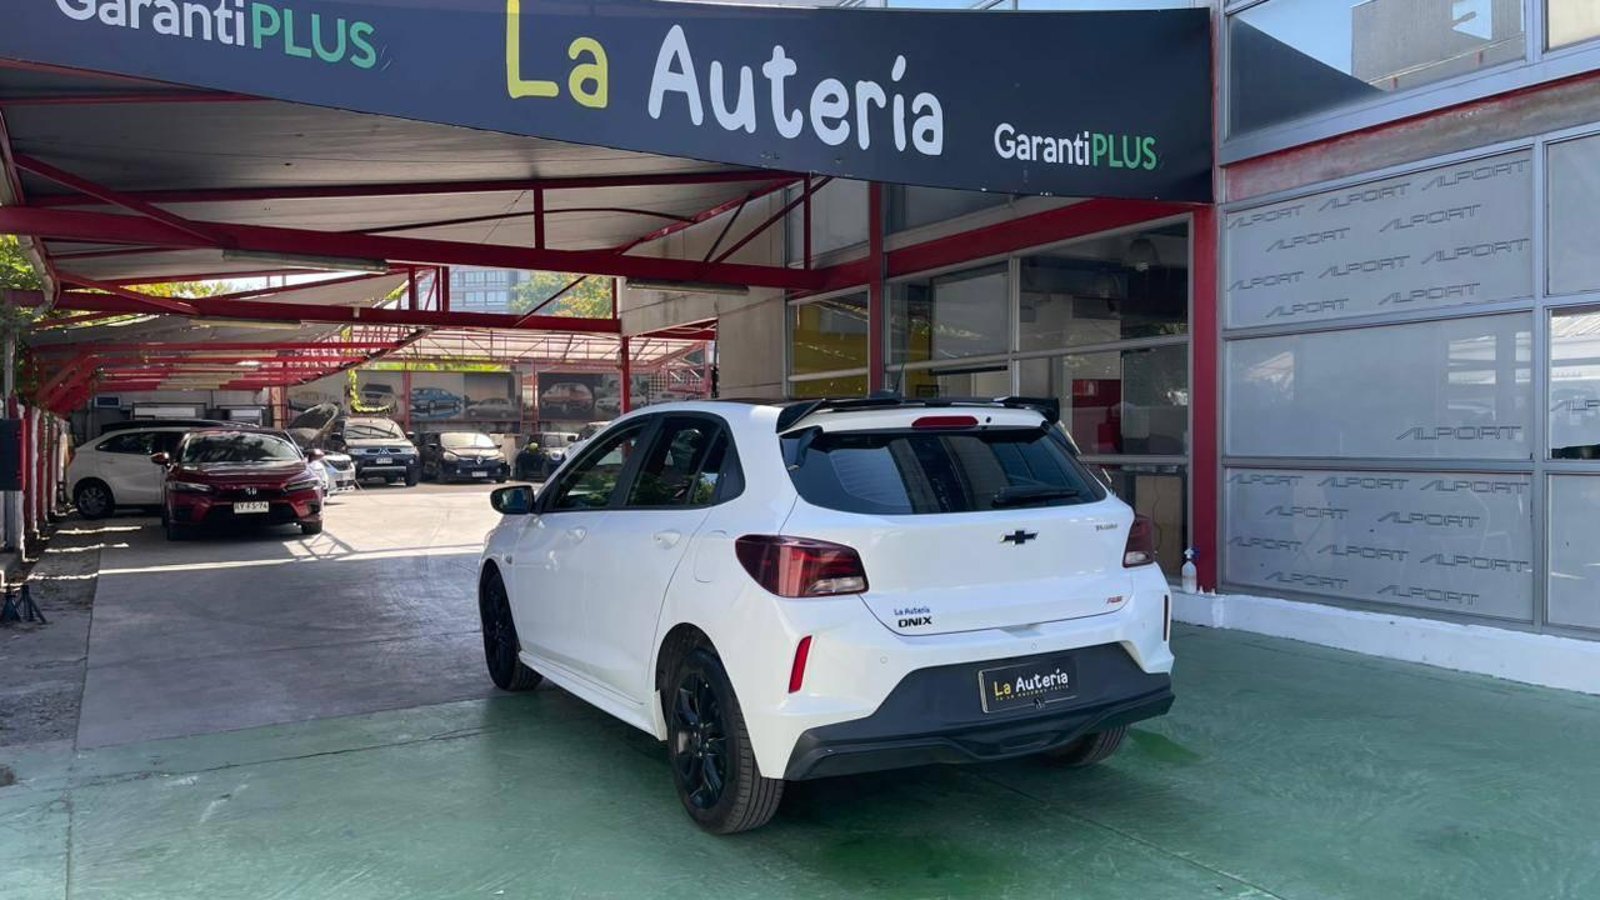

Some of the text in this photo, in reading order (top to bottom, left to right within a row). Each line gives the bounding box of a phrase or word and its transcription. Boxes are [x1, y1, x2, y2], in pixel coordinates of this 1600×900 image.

[506, 0, 945, 156] La Autería
[994, 122, 1158, 171] GarantiPLUS
[1421, 159, 1531, 191] ALPORT
[1318, 183, 1411, 212] ALPORT
[1227, 205, 1305, 230] ALPORT
[1379, 204, 1482, 233] ALPORT
[1266, 227, 1351, 253] ALPORT
[1421, 238, 1531, 265] ALPORT
[1318, 256, 1410, 280] ALPORT
[1227, 271, 1304, 293] ALPORT
[1378, 282, 1481, 306] ALPORT
[1265, 298, 1350, 319] ALPORT
[1396, 426, 1522, 440] ALPORT
[1227, 474, 1303, 488] ALPORT
[1317, 476, 1409, 490] ALPORT
[1420, 479, 1529, 494] ALPORT
[1265, 505, 1349, 519] ALPORT
[1377, 511, 1480, 527] ALPORT
[1228, 537, 1303, 552] ALPORT
[1317, 544, 1409, 562] ALPORT
[1420, 554, 1529, 573] ALPORT
[1265, 571, 1349, 590] ALPORT
[1377, 584, 1480, 606] ALPORT
[898, 616, 932, 628] ONIX
[993, 681, 1012, 696] La
[1015, 668, 1069, 693] Autería
